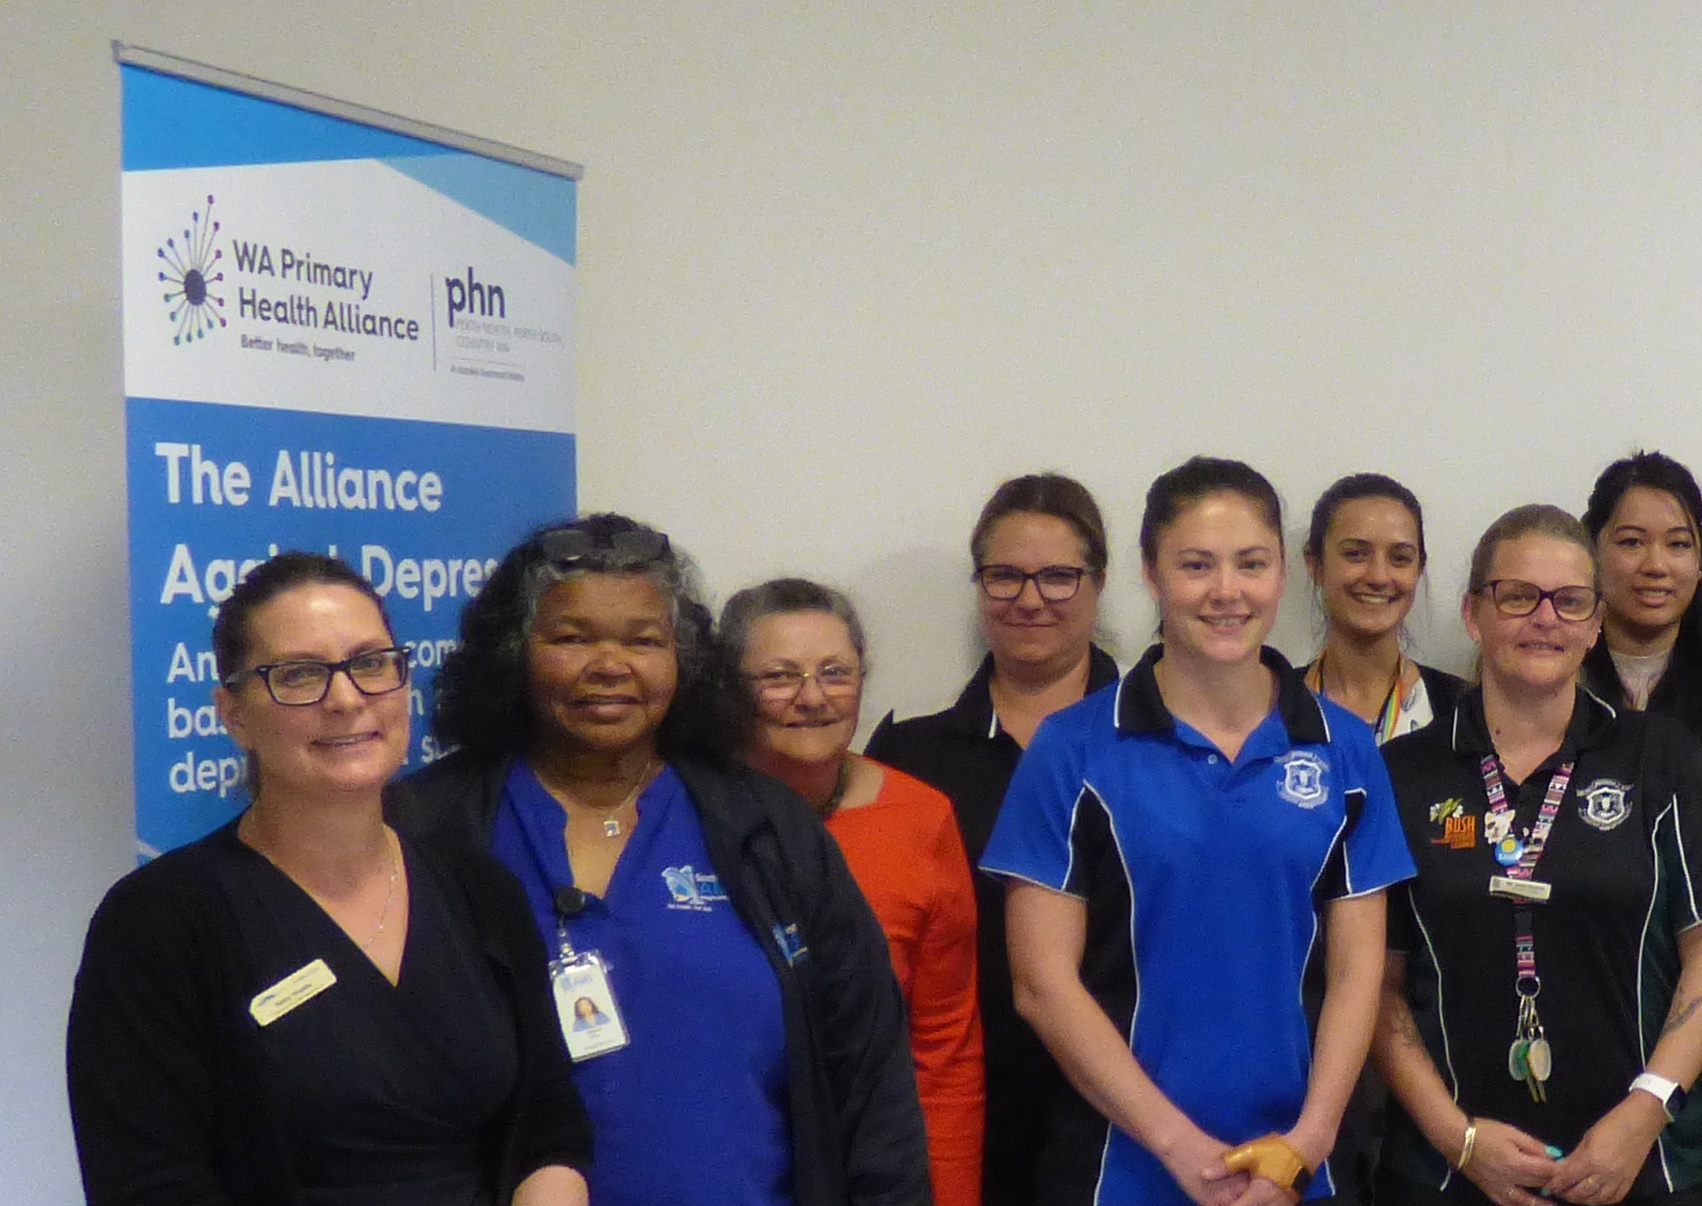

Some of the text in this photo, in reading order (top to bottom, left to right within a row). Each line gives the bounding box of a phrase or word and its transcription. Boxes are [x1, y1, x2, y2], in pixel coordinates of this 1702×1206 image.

[232, 239, 373, 300] WA Primary
[445, 266, 505, 328] phn
[239, 286, 420, 341] Health Alliance
[155, 442, 444, 512] The Alliance
